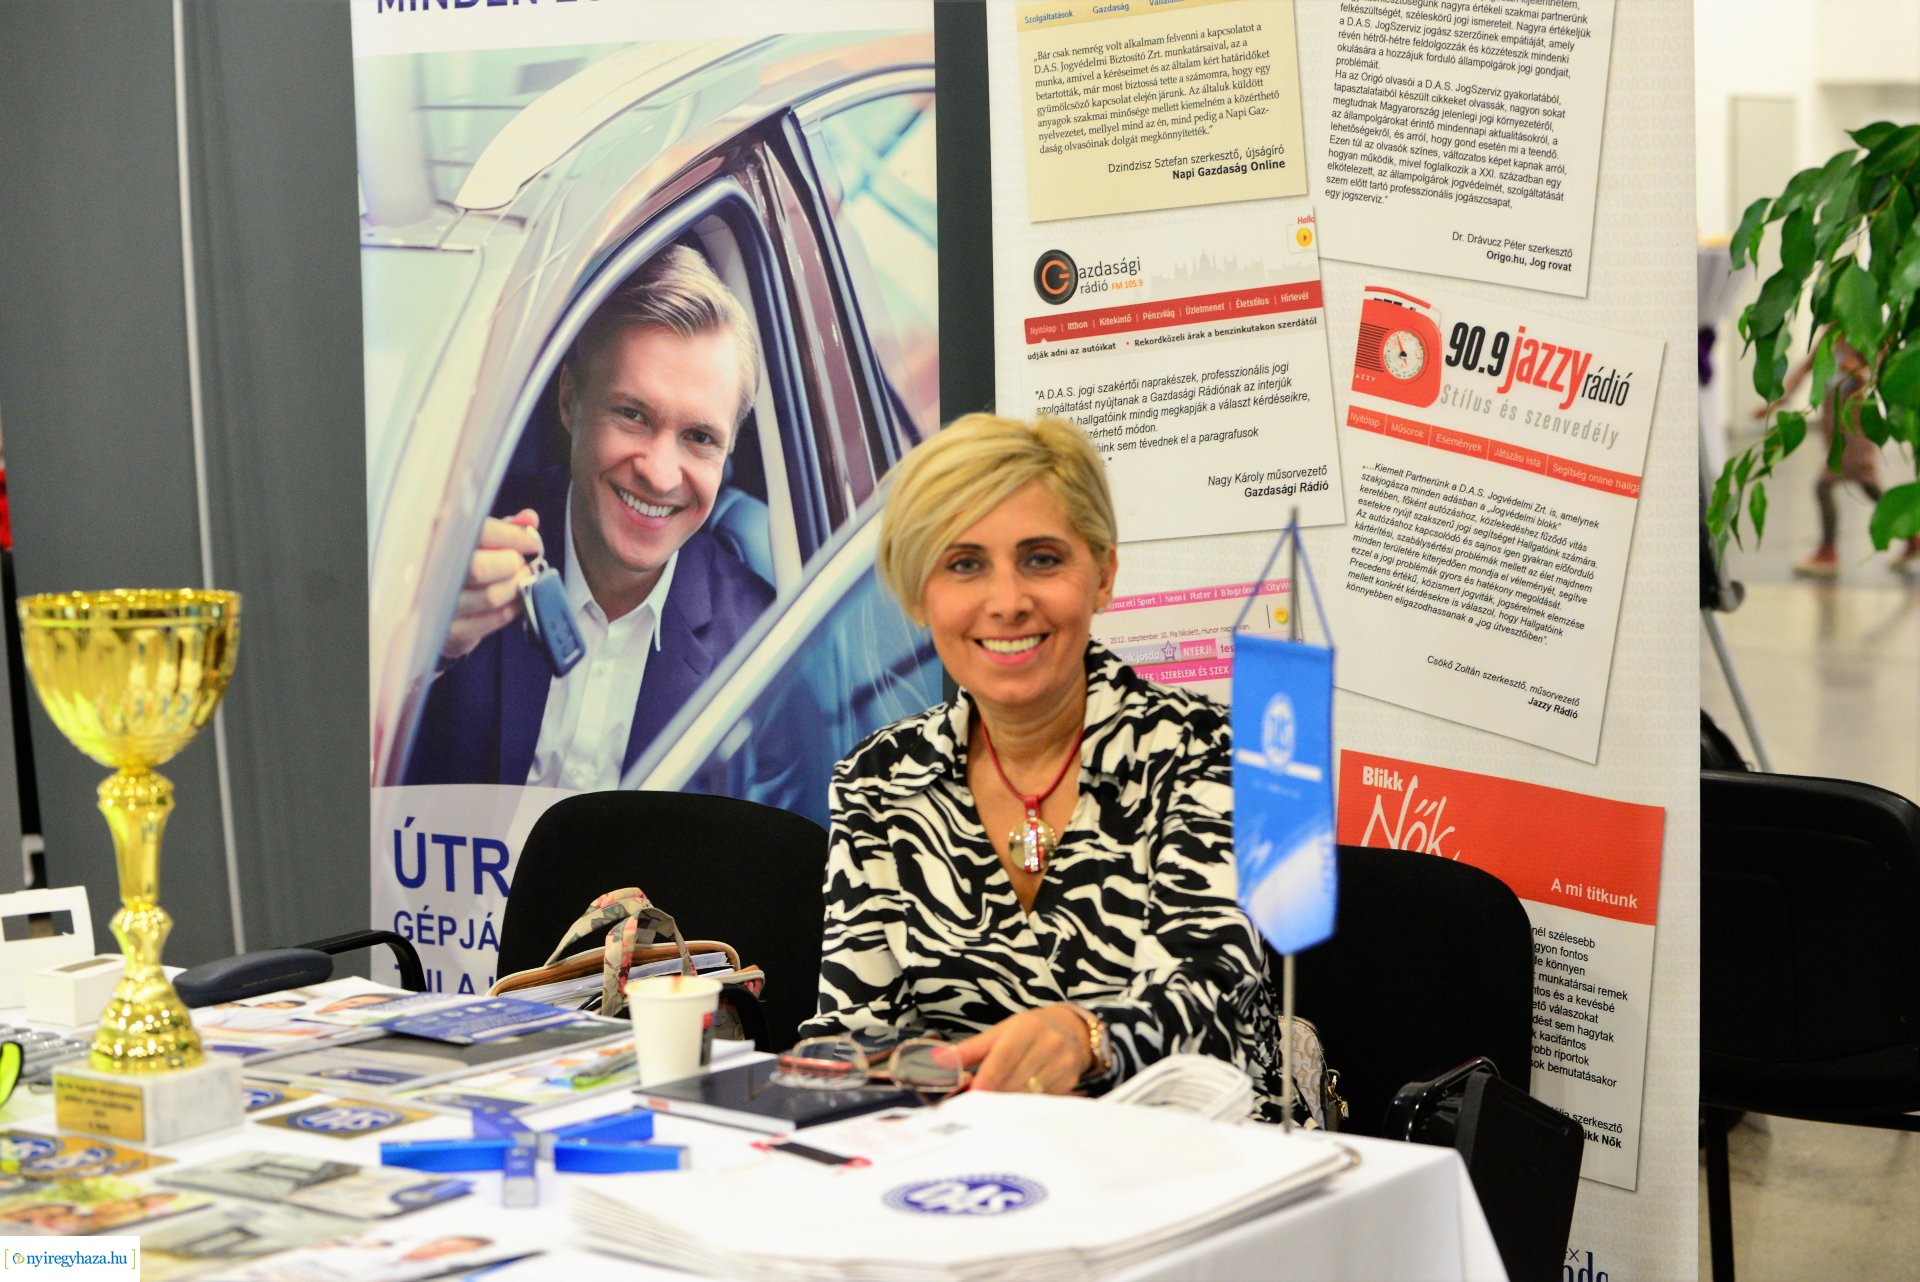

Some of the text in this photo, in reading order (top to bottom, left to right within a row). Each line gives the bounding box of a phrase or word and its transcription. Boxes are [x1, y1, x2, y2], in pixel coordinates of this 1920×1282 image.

[1092, 2, 1129, 14] Gazdaság
[1052, 47, 1070, 58] csak
[1071, 44, 1104, 55] nemrég
[1105, 40, 1122, 51] volt
[1123, 37, 1165, 48] alkalmam
[1166, 30, 1198, 43] felvenni
[1206, 23, 1254, 39] kapcsolatot
[1346, 16, 1373, 28] D.A.S.
[1374, 20, 1421, 33] JogSzerviz
[1422, 24, 1452, 37] jogász
[1453, 24, 1499, 42] szerzőinek
[1500, 35, 1547, 48] empátiáját,
[1548, 40, 1575, 52] amely
[1034, 62, 1060, 74] D.A.S.
[1060, 54, 1107, 72] Jogvédelmi
[1109, 51, 1146, 64] Biztosító
[1147, 49, 1164, 60] Zrt.
[1164, 39, 1230, 57] munkatársaival,
[1333, 82, 1565, 118] tapasztalataiból készült cikkeket olvassák, nagyon sokat
[1039, 141, 1063, 154] daság
[1064, 137, 1109, 150] olvasóinak
[1111, 134, 1138, 147] dolgát
[1108, 143, 1284, 173] Dzindzisz Sztefan szerkesztő, újságíró
[1172, 159, 1285, 180] Napi Gazdaság Online
[1324, 189, 1341, 200] egy
[1452, 231, 1464, 241] Dr.
[1467, 233, 1502, 247] Drávucz
[1503, 238, 1526, 250] Péter
[1486, 250, 1572, 272] Origo.hu, Jog rovat
[1080, 279, 1108, 294] rádió
[1134, 333, 1185, 346] Rekordközeli
[1186, 330, 1205, 340] árak
[1214, 323, 1275, 336] benzinkutakon
[1277, 316, 1317, 329] szerdától
[1027, 350, 1048, 360] udják
[1050, 348, 1068, 357] adni
[1081, 342, 1116, 353] autóikat
[1445, 322, 1633, 410] 90.9 jazzy rádió
[1047, 386, 1076, 400] D.A.S.
[1078, 384, 1095, 398] jogi
[1097, 378, 1139, 393] szakértői
[1141, 372, 1199, 389] naprakészek,
[1201, 363, 1269, 383] professzionális
[1271, 361, 1288, 376] jogi
[1094, 394, 1139, 410] nyújtanak
[1141, 395, 1147, 403] a
[1150, 387, 1196, 402] Gazdasági
[1198, 382, 1241, 396] Rádiónak
[1243, 382, 1255, 391] az
[1257, 376, 1292, 390] interjúk
[1440, 384, 1619, 450] Stílus és szenvedély
[1207, 464, 1327, 487] Nagy Károly műsorvezető
[1244, 480, 1328, 497] Gazdasági Rádió
[1404, 470, 1450, 488] Partnerünk
[1458, 483, 1485, 498] D.A.S.
[1488, 491, 1533, 511] Jogvédelmi
[1534, 503, 1547, 514] Zrt.
[1549, 509, 1559, 518] is,
[1560, 512, 1599, 528] amelynek
[1345, 581, 1393, 601] könnyebben
[1394, 596, 1466, 621] eligazodhassanak
[1427, 655, 1580, 706] Csökő Zoltán szerkesztő, műsorvezető
[1527, 696, 1578, 719] Jazzy Rádió
[1362, 766, 1403, 792] Blikk
[1360, 775, 1456, 856] Nők
[1551, 878, 1638, 909] A mi titkunk
[1548, 930, 1595, 948] szélesebb
[1559, 946, 1588, 962] fontos
[1545, 957, 1585, 975] könnyen
[1538, 972, 1628, 1000] munkatársai remek
[1552, 989, 1615, 1012] és a kevésbé
[1548, 1004, 1598, 1023] válaszokat
[1539, 1030, 1586, 1050] kacifántos
[1554, 1021, 1614, 1042] sem hagytak
[1553, 1048, 1589, 1066] riportok
[1547, 1061, 1617, 1087] bemutatásakor
[1601, 1134, 1621, 1148] Nők
